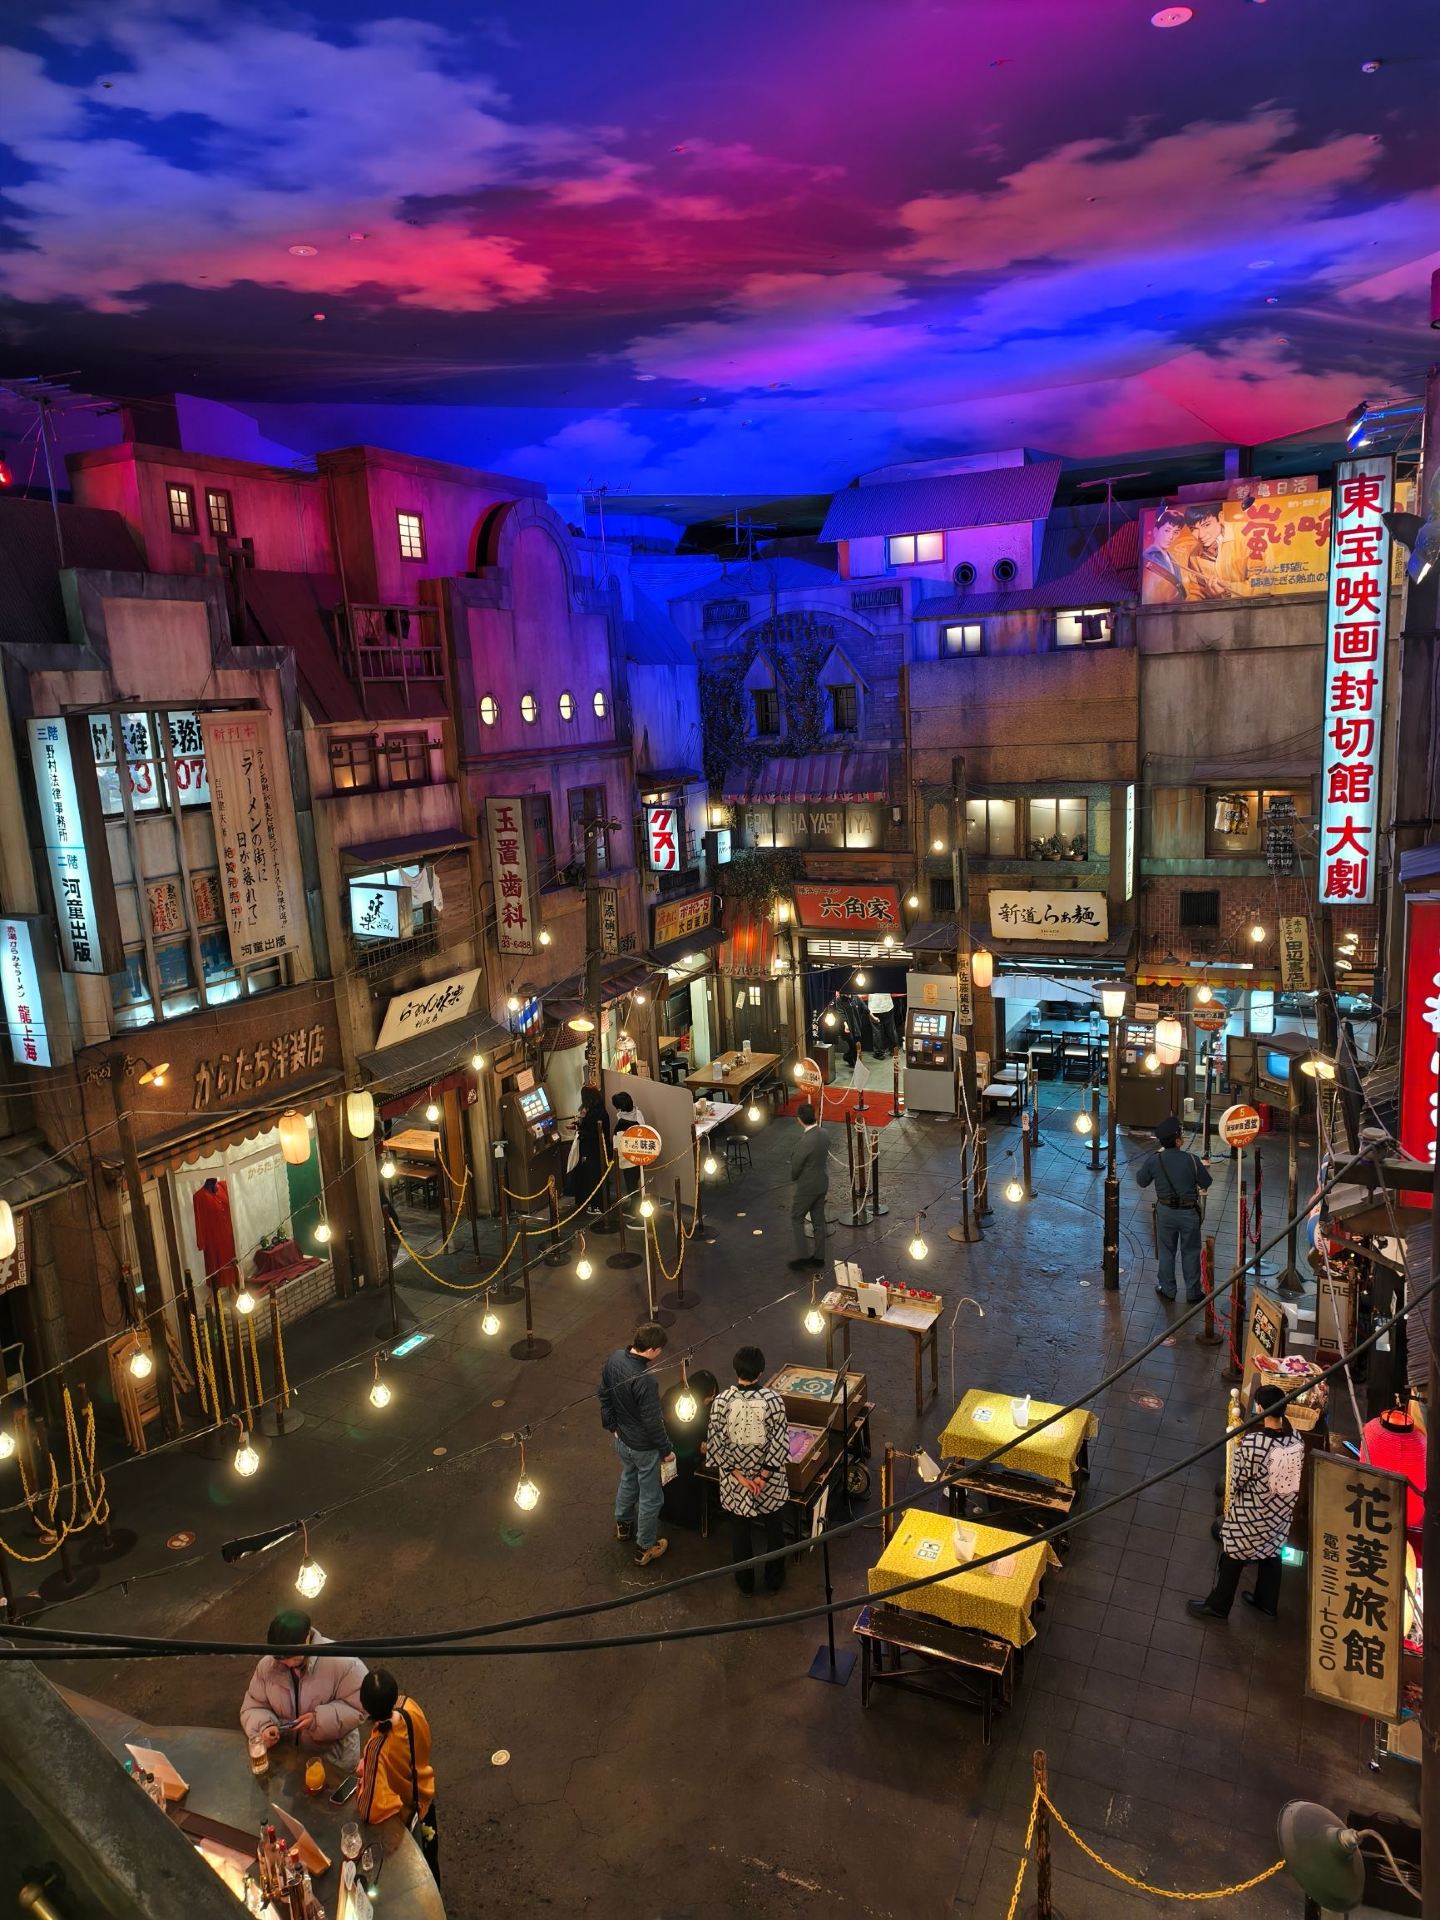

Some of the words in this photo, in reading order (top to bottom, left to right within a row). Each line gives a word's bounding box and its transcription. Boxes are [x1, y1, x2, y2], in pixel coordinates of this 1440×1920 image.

[36, 726, 58, 741] 三階
[45, 744, 68, 842] 野村法律事務所
[57, 854, 79, 870] 二階
[494, 806, 528, 931] 玉置歯科
[650, 810, 676, 870] クスリ
[61, 877, 92, 963] 河童出版
[819, 896, 894, 921] 六角家
[240, 935, 288, 957] 河童出版
[17, 1004, 38, 1062] 龍上海
[193, 1023, 326, 1110] からたち洋装店
[637, 1128, 643, 1137] 2
[1341, 1483, 1393, 1680] 花菱旅館
